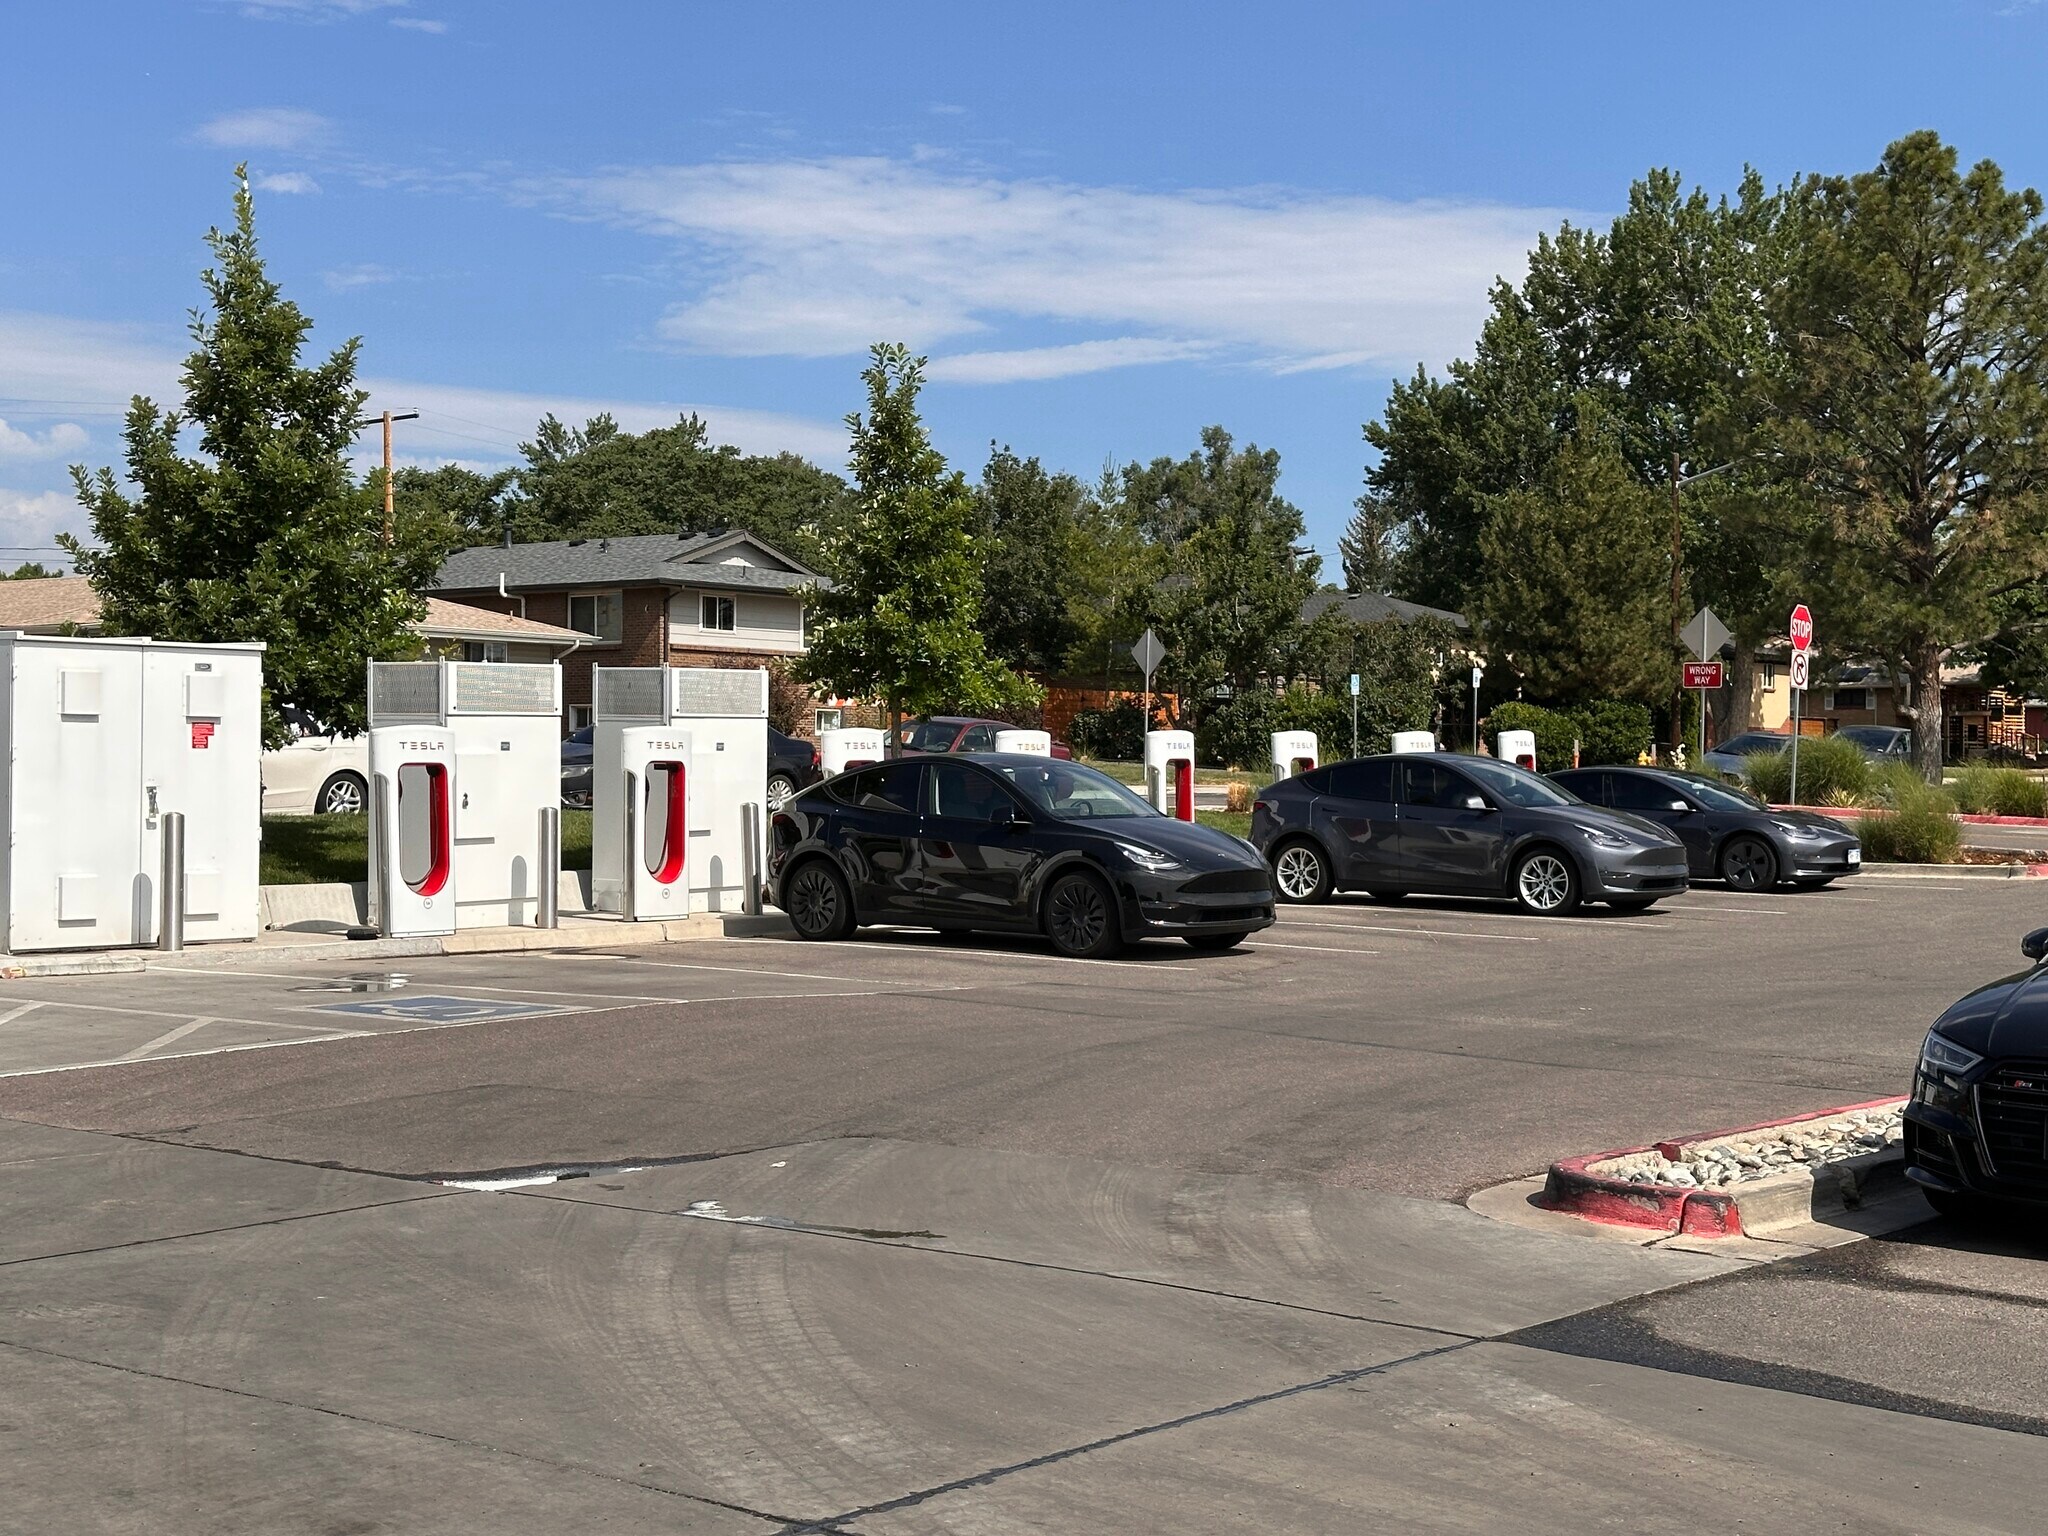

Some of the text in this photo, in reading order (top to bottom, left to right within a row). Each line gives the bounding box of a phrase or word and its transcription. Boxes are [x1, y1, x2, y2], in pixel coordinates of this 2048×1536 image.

[1792, 619, 1811, 638] STOP
[1689, 666, 1716, 675] WRONG
[1694, 676, 1711, 684] WAY
[399, 741, 444, 750] TESLA
[647, 741, 684, 750] TESLA
[845, 742, 877, 750] TESLA
[1017, 743, 1045, 751] TESLA
[1166, 742, 1190, 750] TESLA
